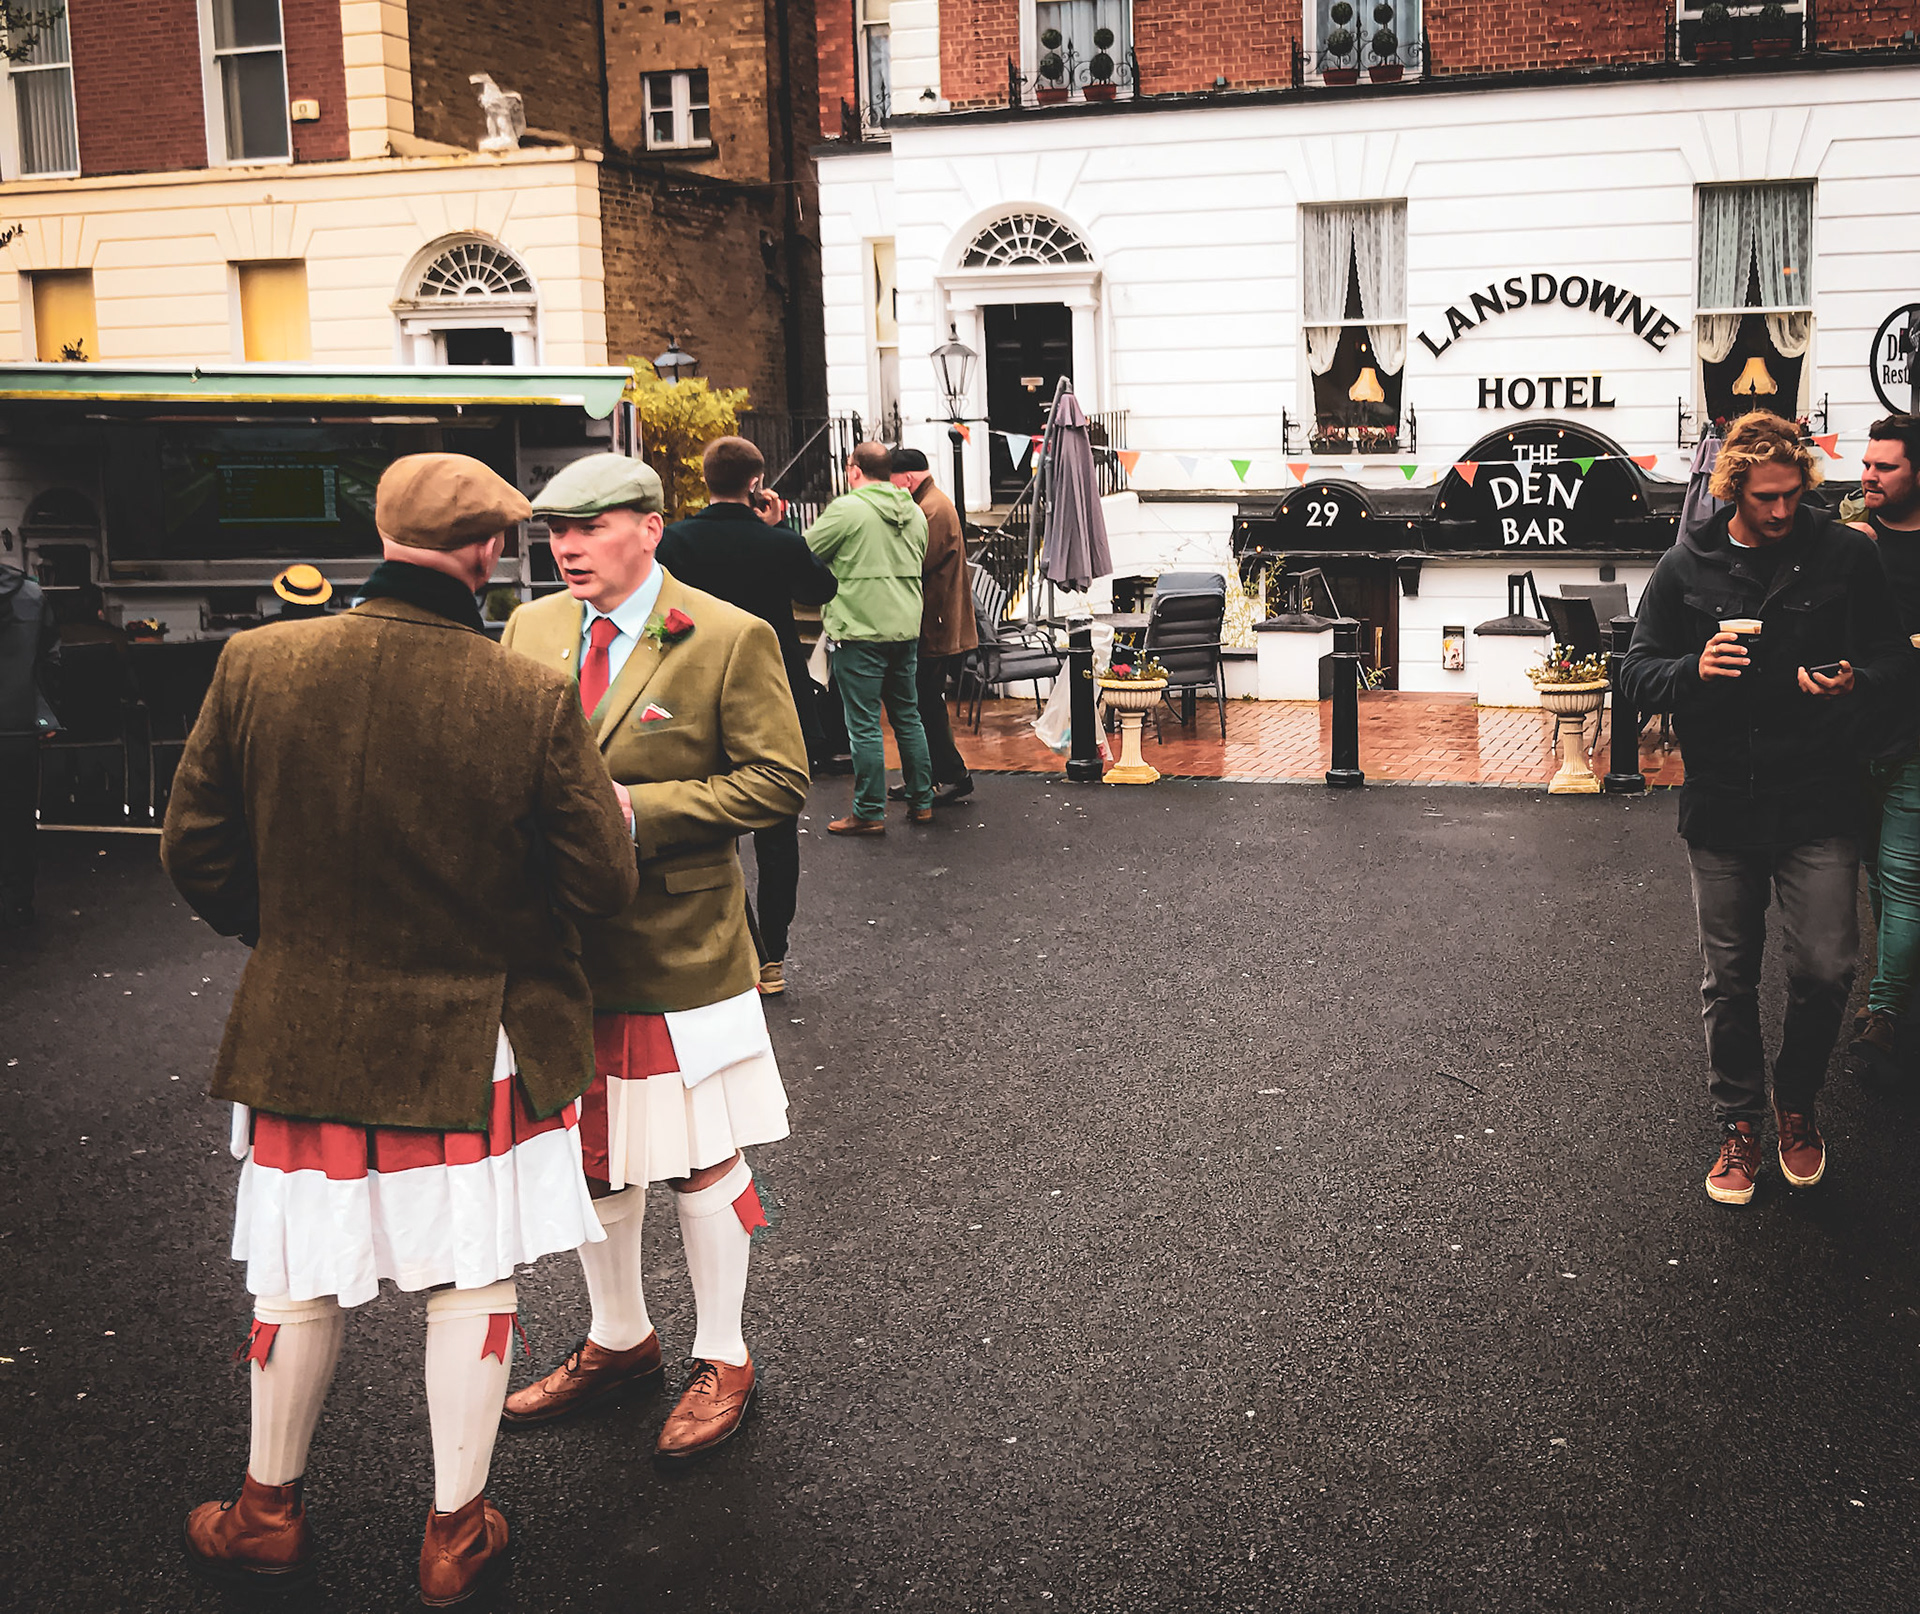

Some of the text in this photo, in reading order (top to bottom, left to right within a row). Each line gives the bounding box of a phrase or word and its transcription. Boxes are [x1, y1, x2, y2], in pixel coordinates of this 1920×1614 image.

[1417, 273, 1681, 359] LANSDOWNE
[1477, 376, 1616, 410] HOTEL
[1512, 443, 1559, 466] THE
[1489, 472, 1584, 511] DEN
[1306, 501, 1340, 528] 29
[1501, 517, 1568, 546] BAR
